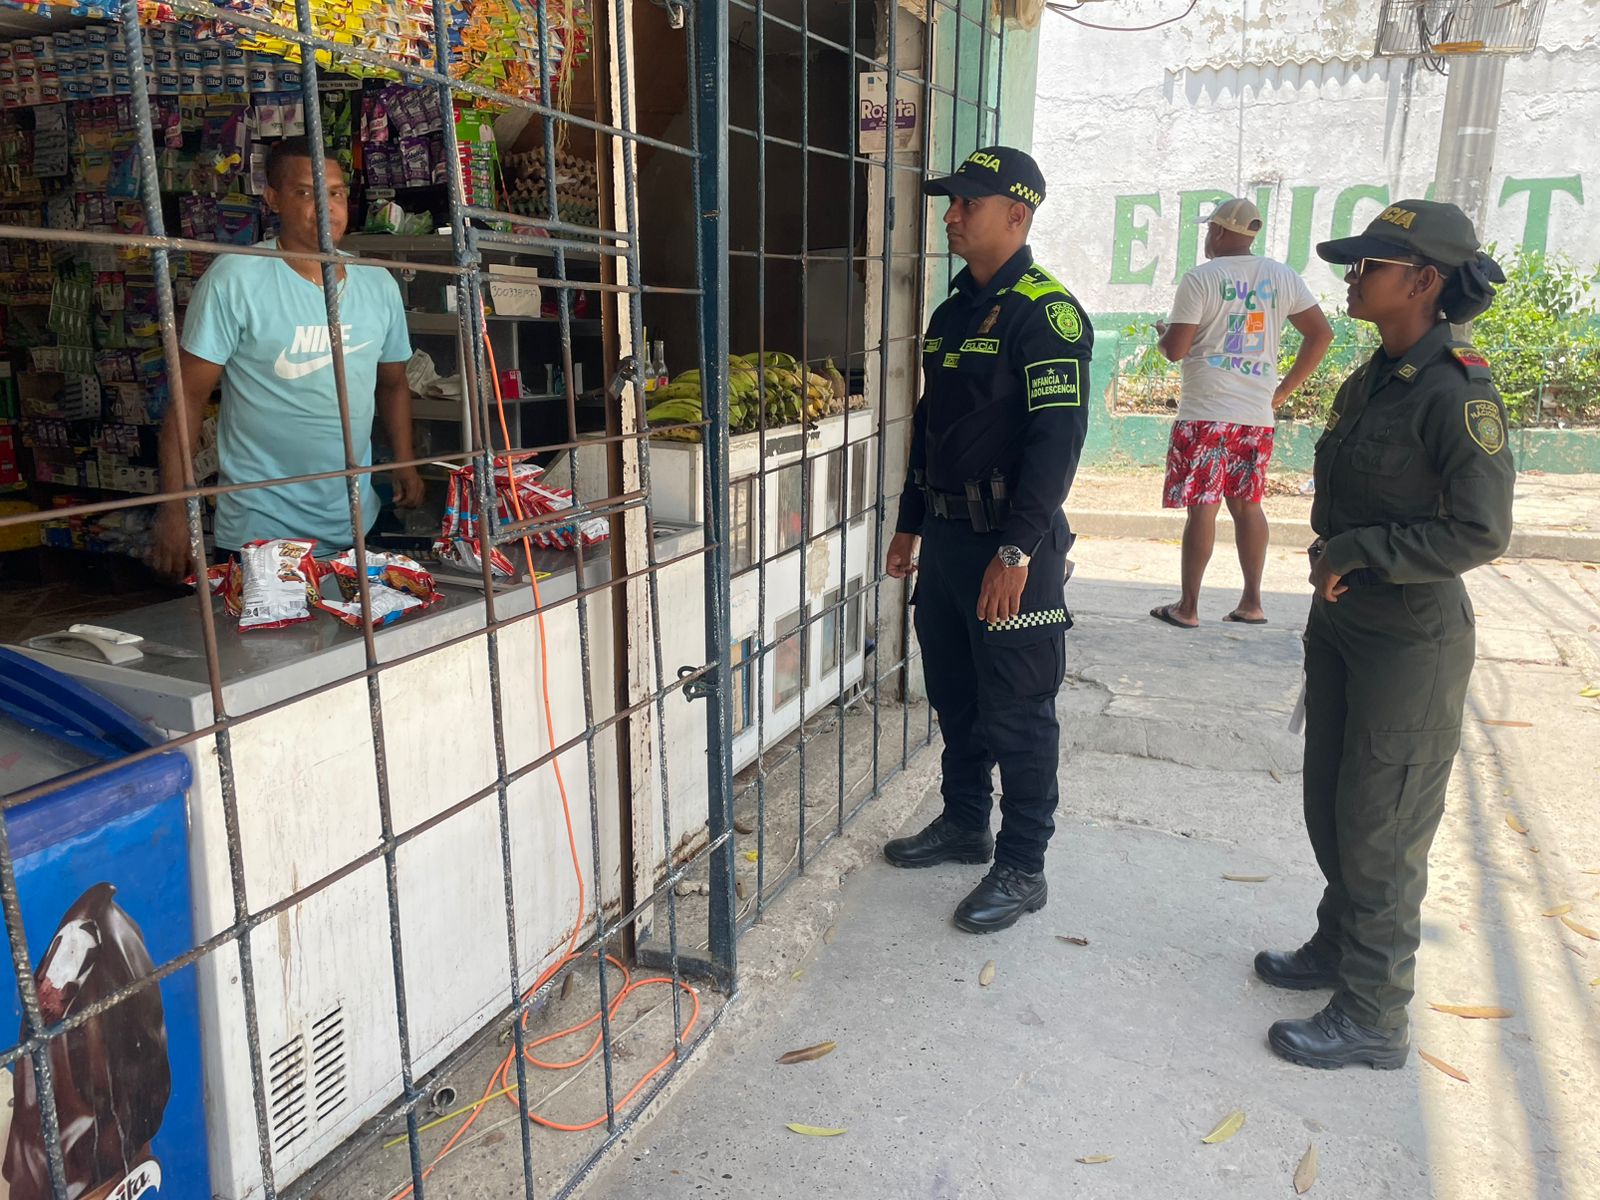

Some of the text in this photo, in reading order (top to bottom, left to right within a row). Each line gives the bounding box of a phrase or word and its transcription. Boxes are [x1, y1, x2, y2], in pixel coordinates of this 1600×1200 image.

[227, 77, 242, 85] Elite
[1220, 279, 1278, 310] GUCCI
[1063, 374, 1068, 384] Y
[1031, 384, 1076, 399] ADOLESCENCIA
